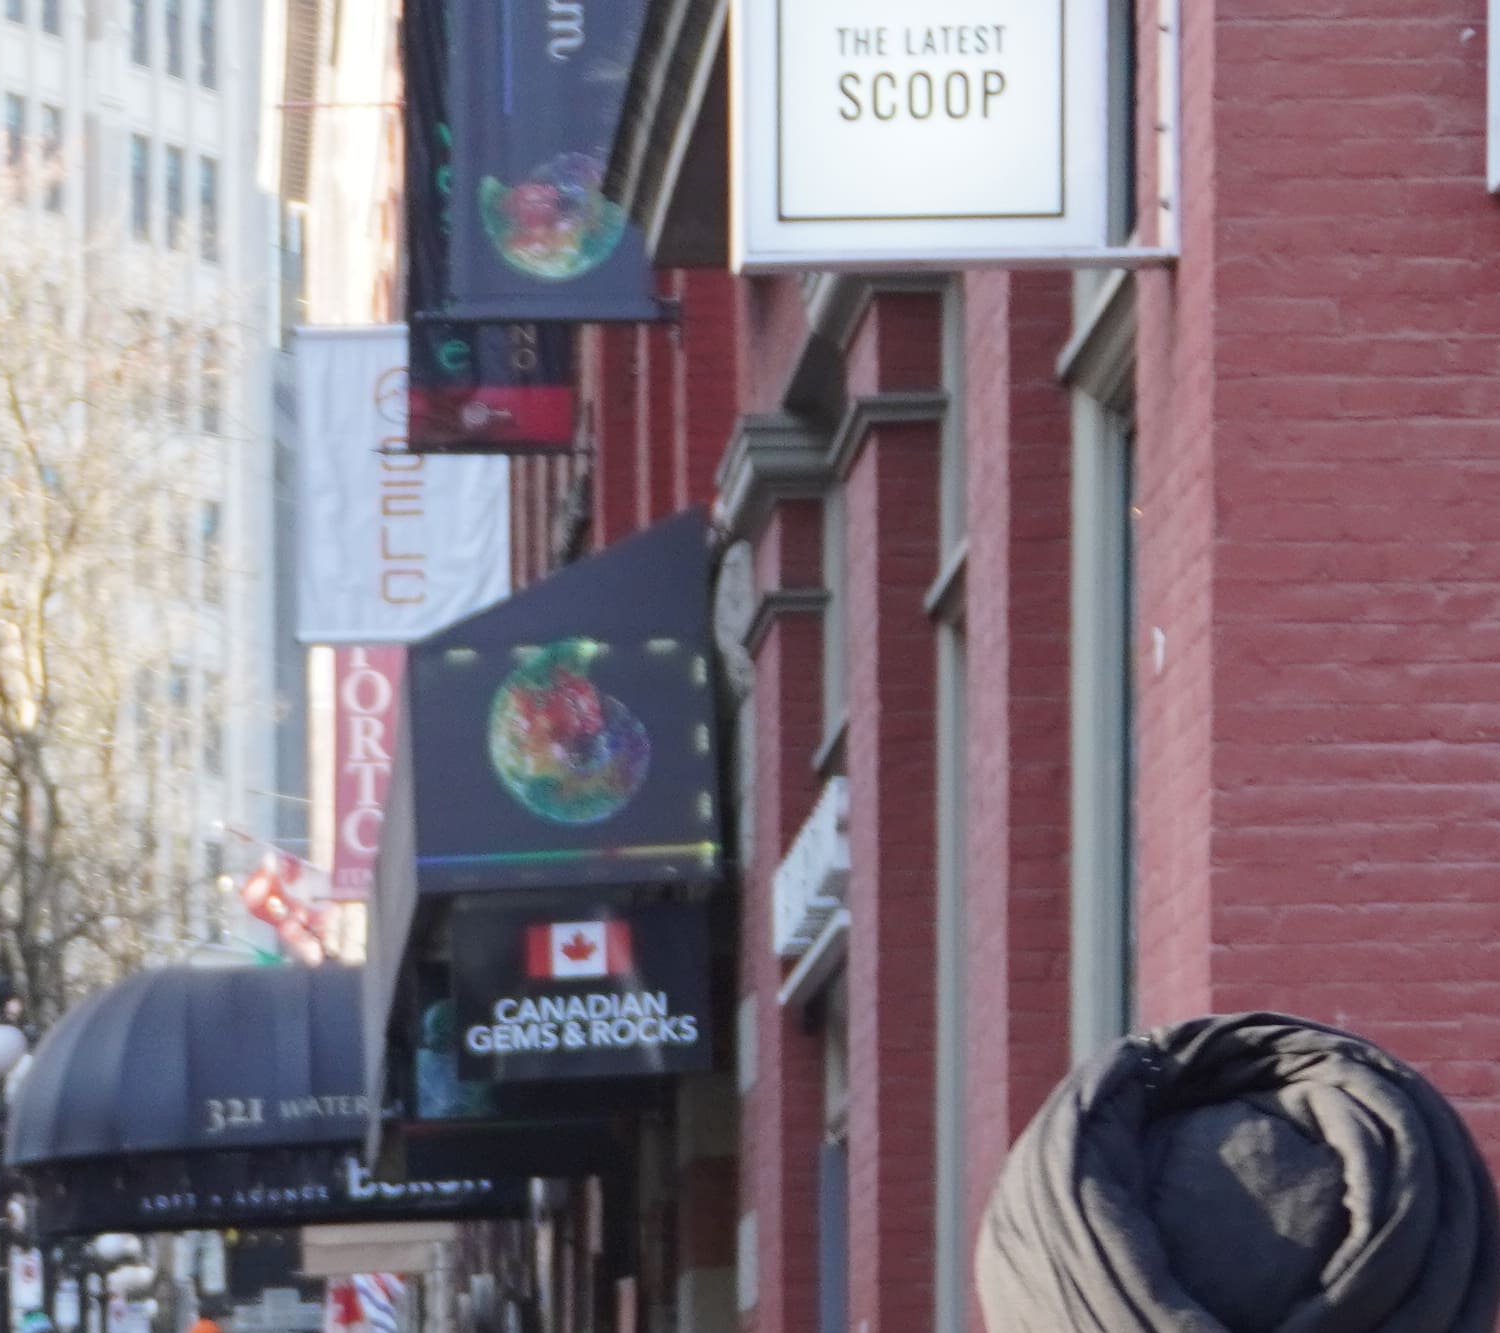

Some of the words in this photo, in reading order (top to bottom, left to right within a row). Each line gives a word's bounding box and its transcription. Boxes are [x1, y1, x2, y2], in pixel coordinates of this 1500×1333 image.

[836, 27, 886, 57] THE
[905, 24, 1008, 56] LATEST
[837, 68, 1007, 121] SCOOP
[494, 991, 668, 1025] CANADIAN
[466, 1022, 559, 1052] GEMS
[562, 1020, 586, 1048] &
[592, 1015, 698, 1046] ROCKS
[206, 1098, 264, 1134] 321
